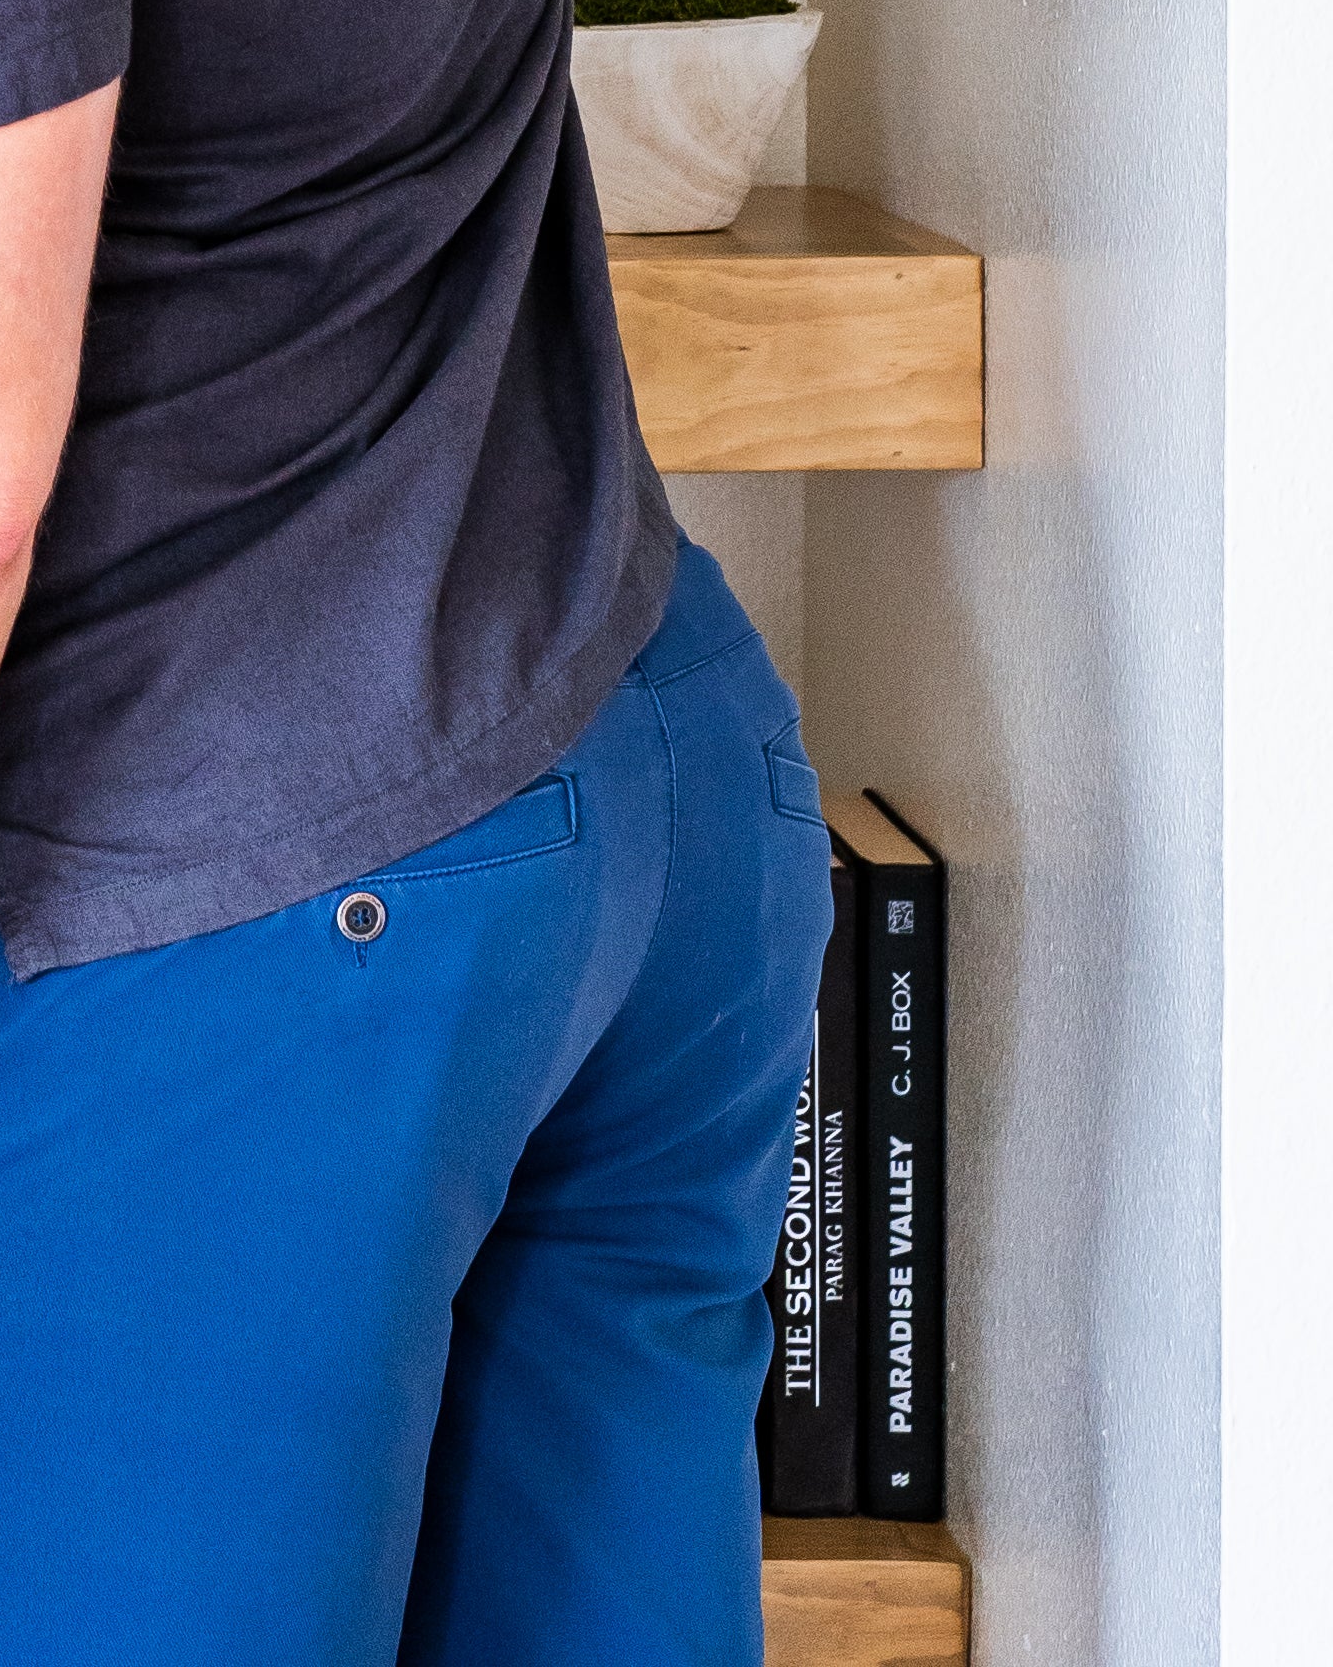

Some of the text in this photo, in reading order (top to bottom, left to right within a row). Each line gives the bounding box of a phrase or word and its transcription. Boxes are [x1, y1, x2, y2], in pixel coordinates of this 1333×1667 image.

[891, 971, 912, 1097] C. J. BOX
[785, 1157, 812, 1315] SECOND
[824, 1110, 843, 1302] PARAG KHANNA
[888, 1135, 913, 1433] PARADISE VALLEY
[786, 1325, 811, 1396] THE
